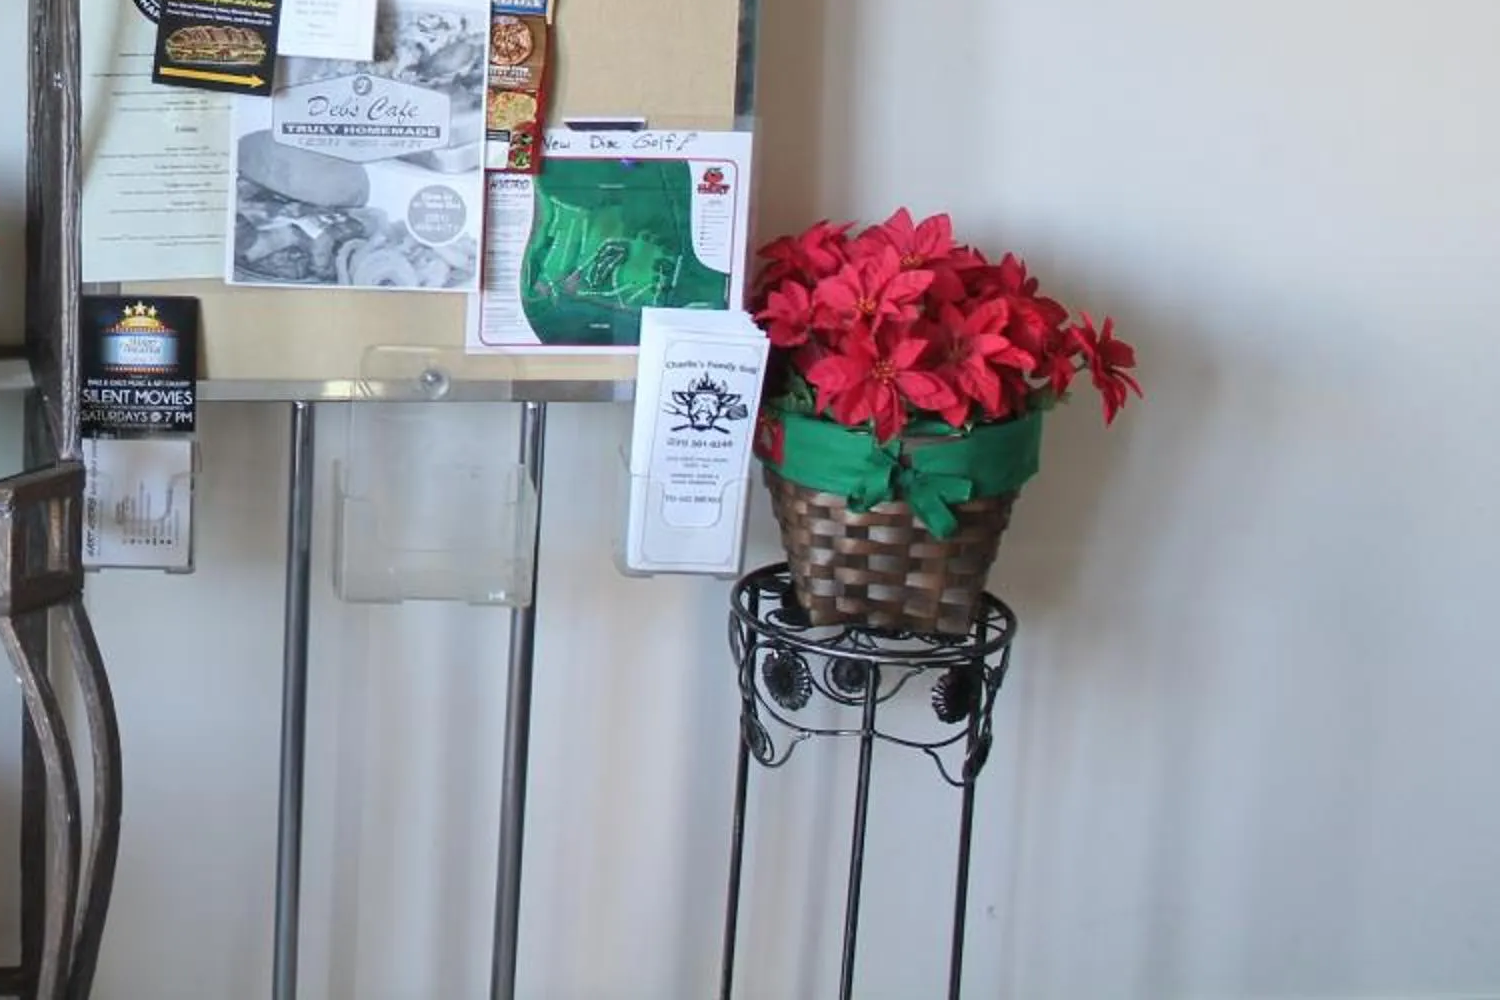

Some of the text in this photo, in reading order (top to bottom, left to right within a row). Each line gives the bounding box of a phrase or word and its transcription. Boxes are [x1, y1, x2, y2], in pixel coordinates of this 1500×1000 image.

[366, 94, 421, 124] Cafe
[286, 124, 440, 138] TRULY HOMEMADE
[542, 135, 571, 150] New
[82, 388, 193, 405] SILENT MOVIES
[81, 410, 149, 424] SATURDAYS
[163, 410, 172, 423] 7
[175, 410, 194, 424] PM
